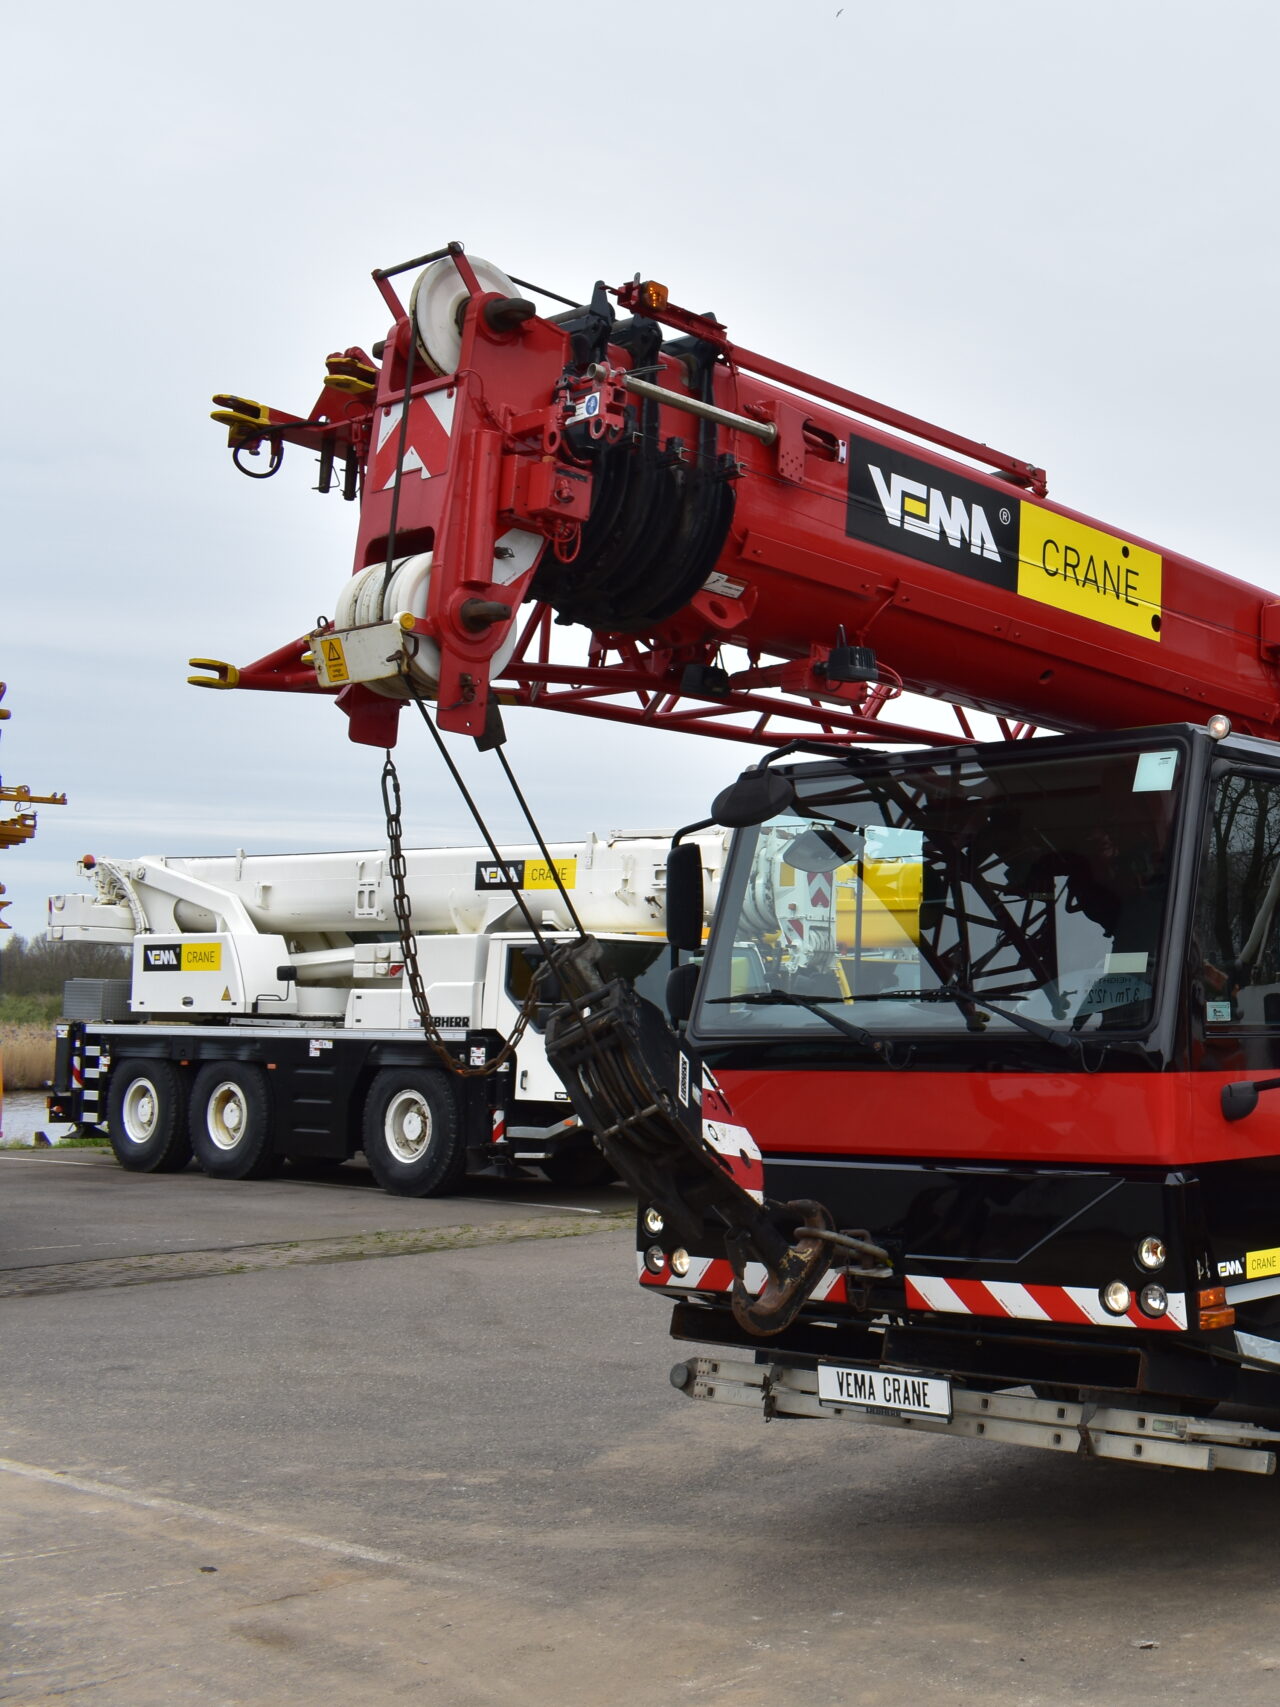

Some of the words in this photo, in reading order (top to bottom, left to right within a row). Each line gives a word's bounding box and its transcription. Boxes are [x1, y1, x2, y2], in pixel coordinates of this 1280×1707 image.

[867, 463, 1002, 563] VEMA
[1042, 538, 1140, 607] CRANE
[147, 950, 178, 965] VEMA
[186, 951, 215, 963] CRANE
[1251, 1255, 1277, 1271] CRANE
[836, 1371, 876, 1401] VEMA
[883, 1376, 930, 1409] CRANE
